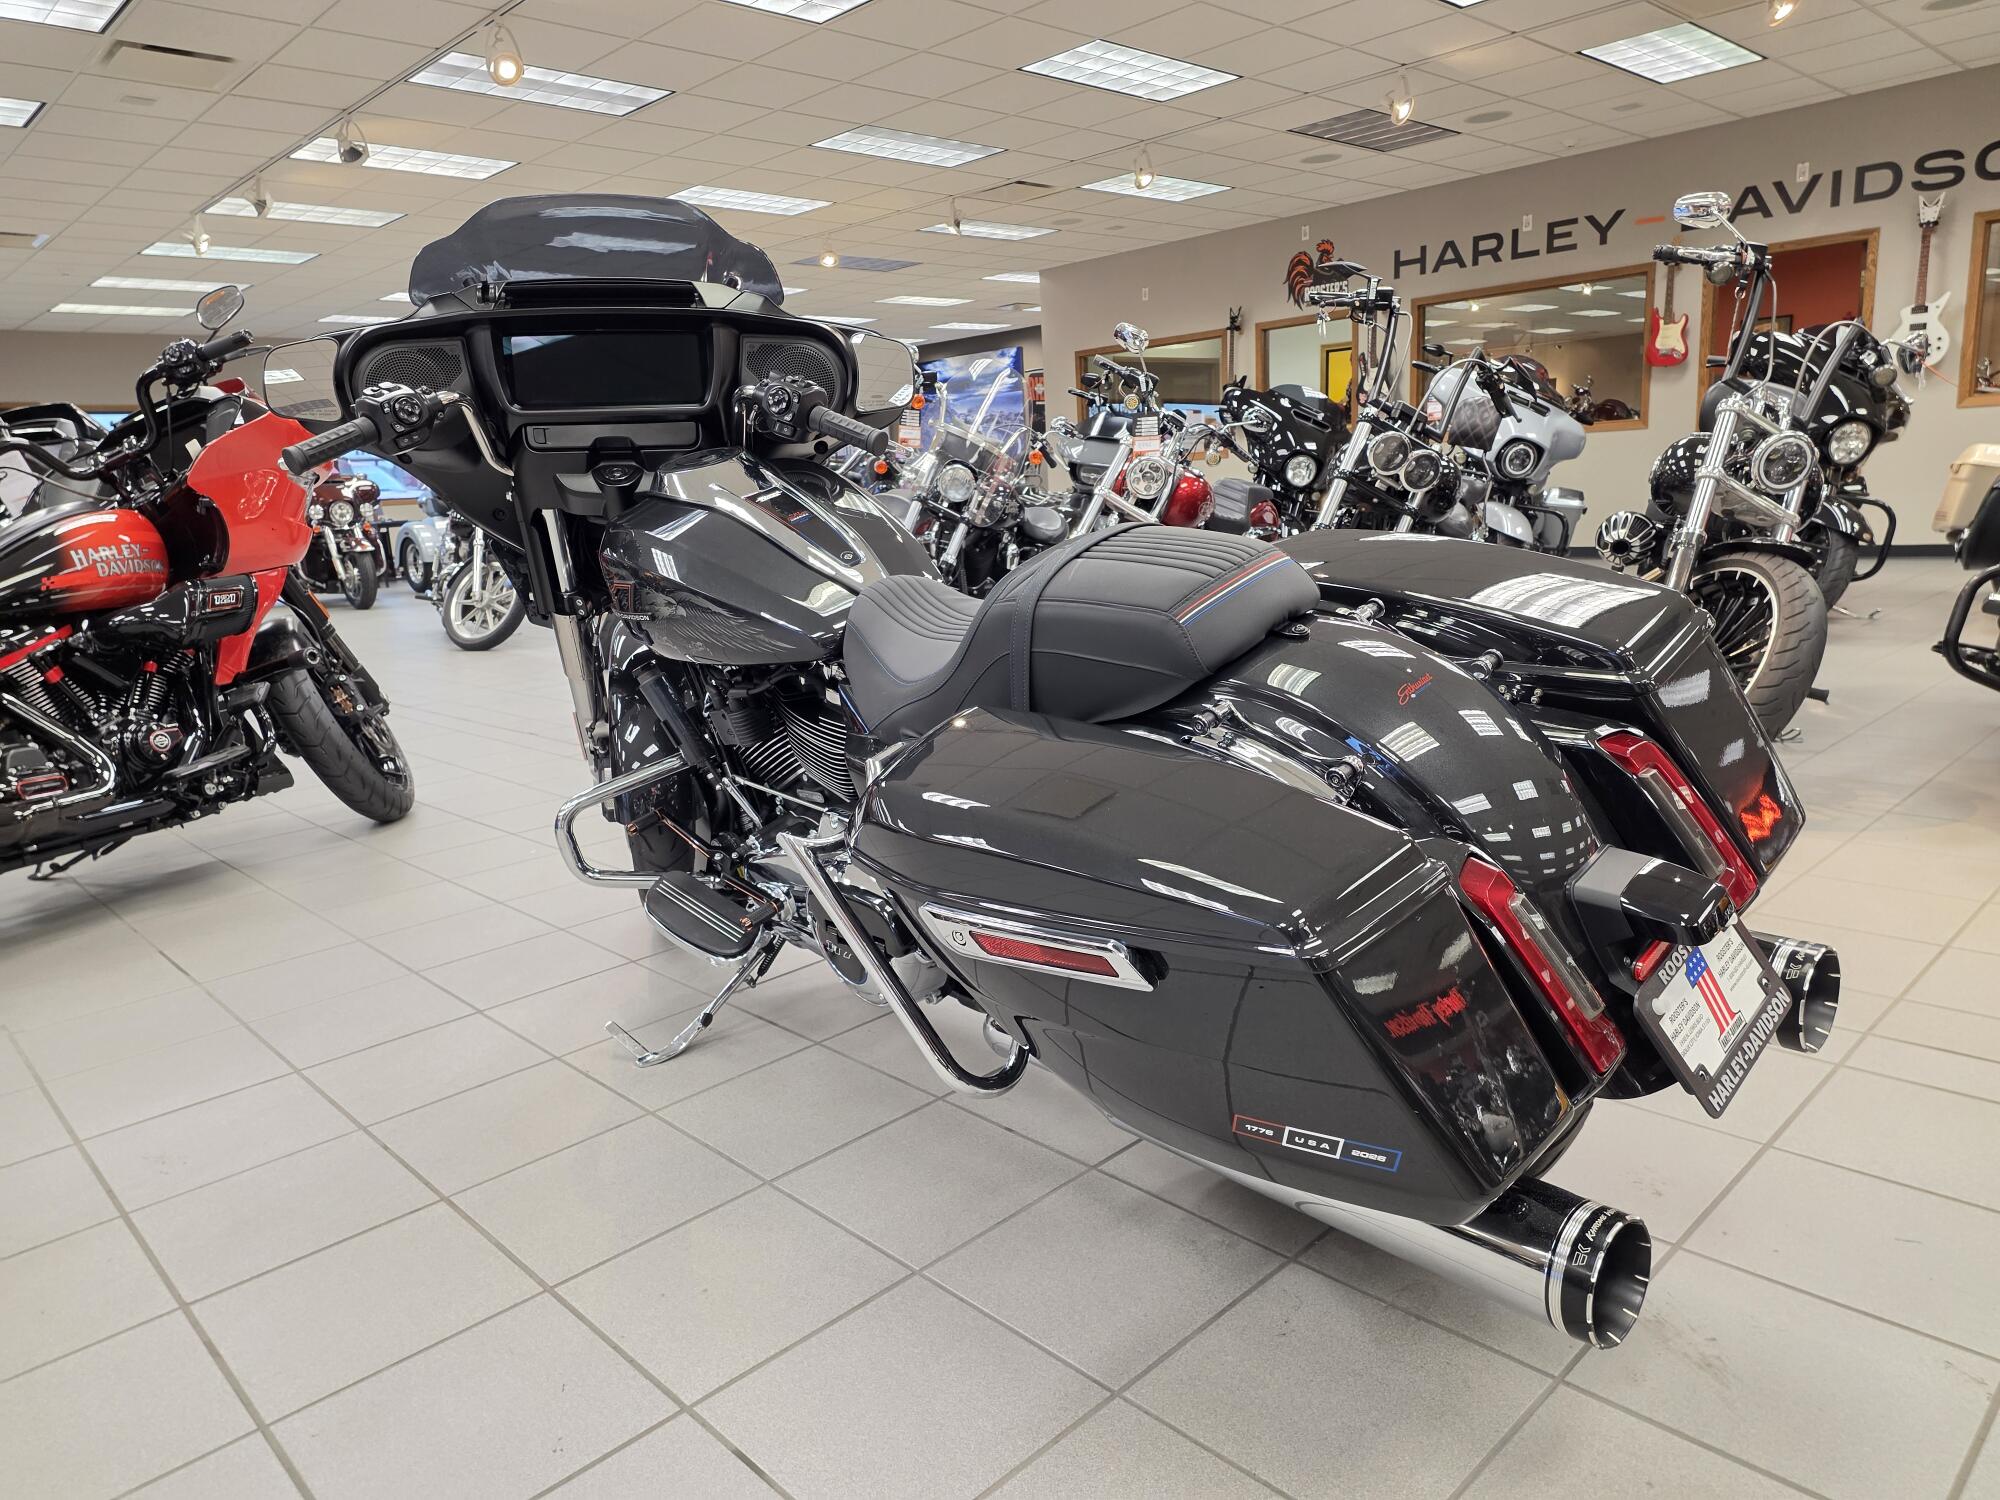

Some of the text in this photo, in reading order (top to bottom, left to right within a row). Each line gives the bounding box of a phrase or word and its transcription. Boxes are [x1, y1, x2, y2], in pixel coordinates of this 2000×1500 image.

[1708, 987, 1791, 1112] HARLEY-DAVIDSON
[1245, 1124, 1274, 1136] 1776
[1351, 1149, 1387, 1163] 2026
